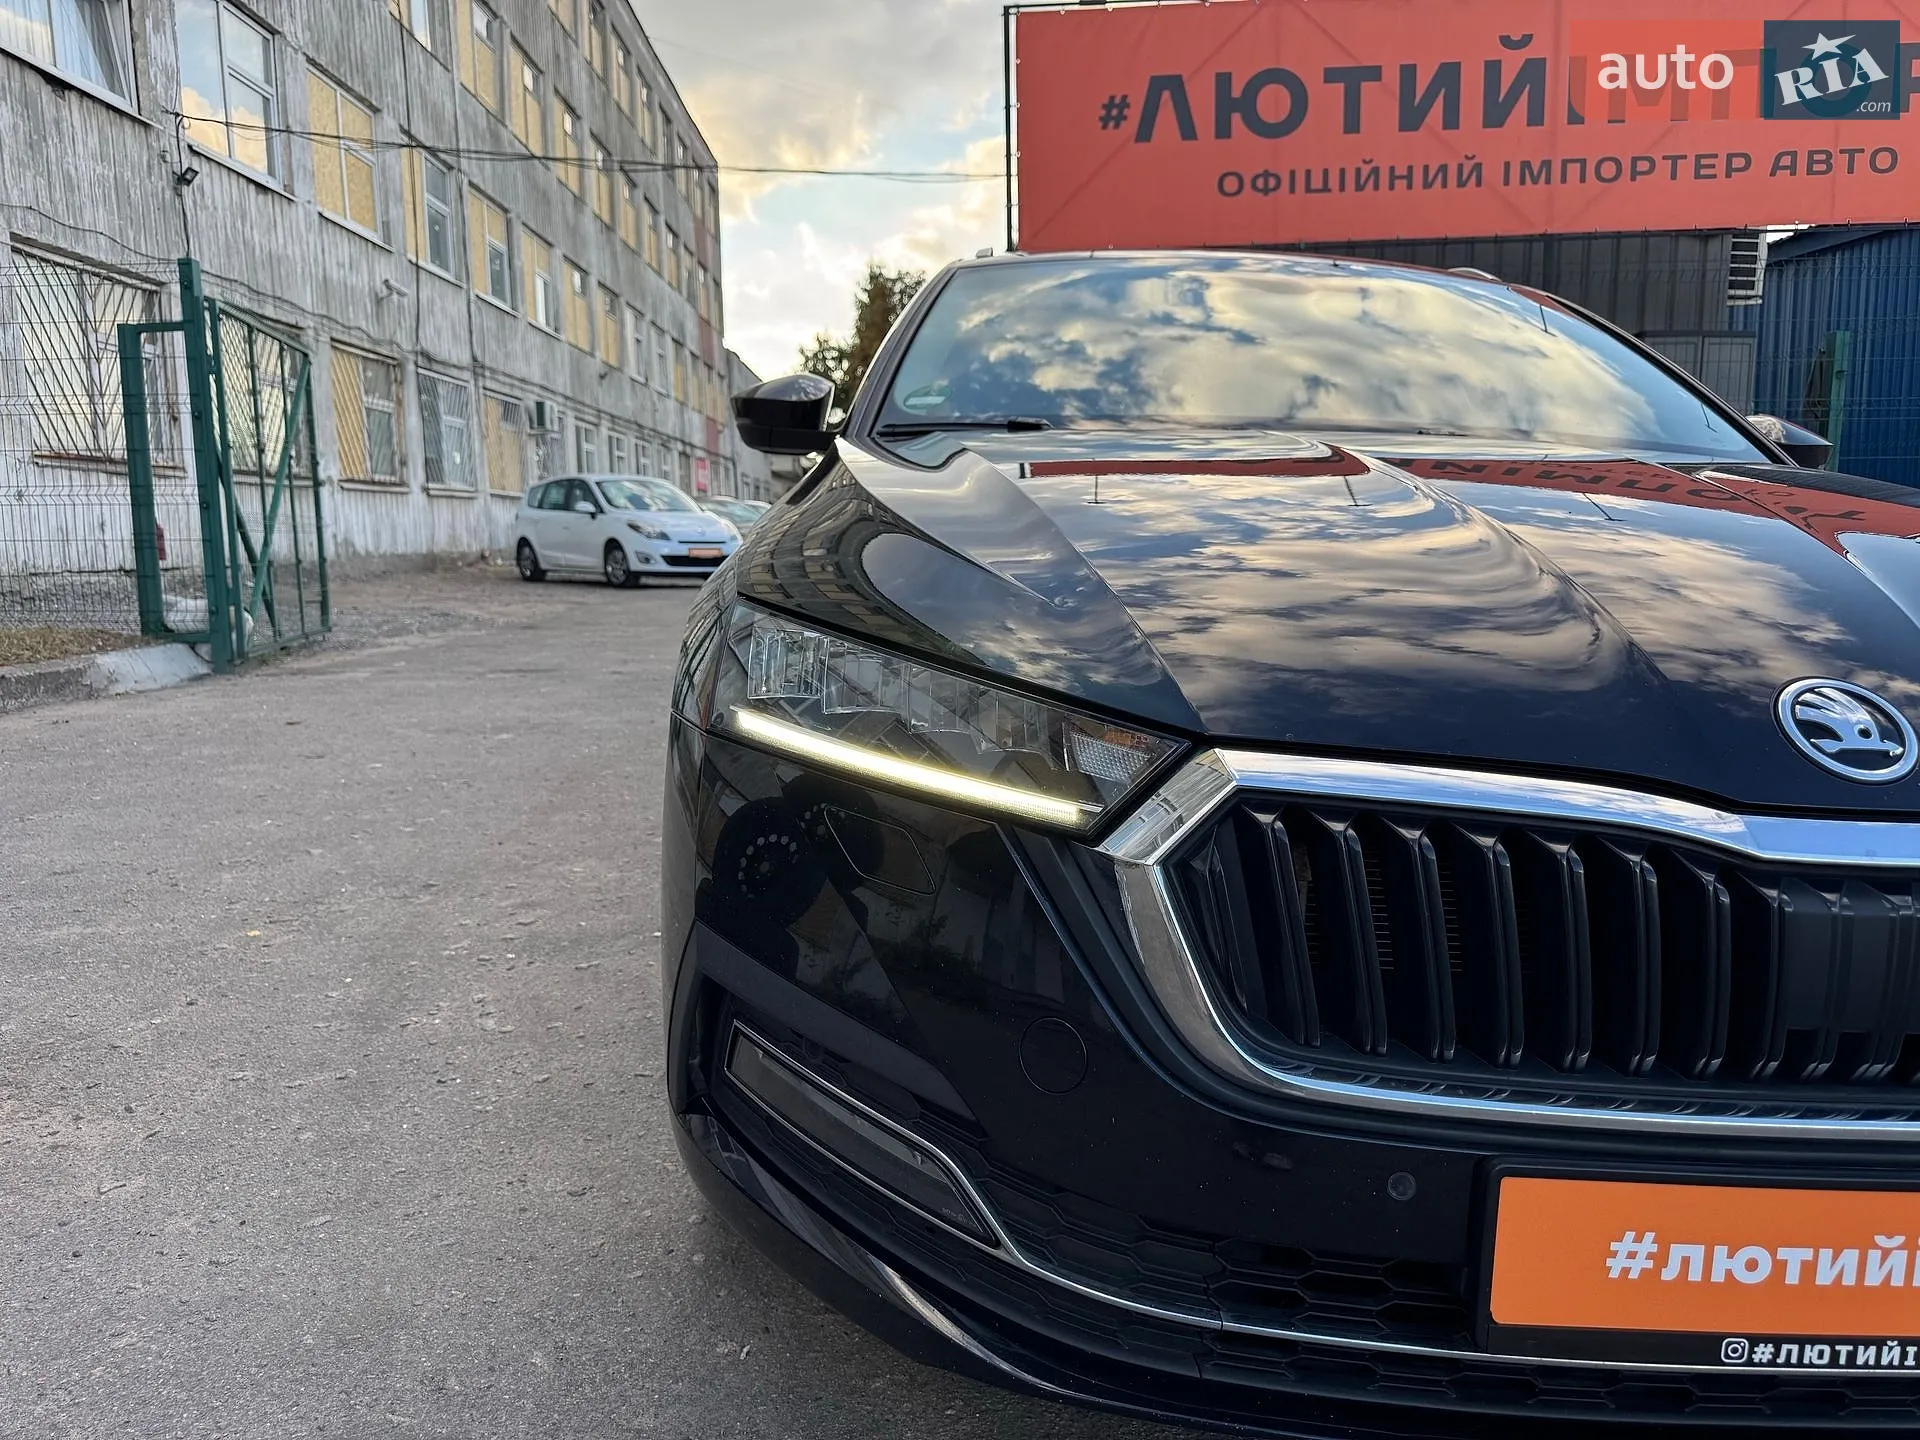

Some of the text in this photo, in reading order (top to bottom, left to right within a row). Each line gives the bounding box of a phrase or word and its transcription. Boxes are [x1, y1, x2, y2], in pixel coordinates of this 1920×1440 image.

[1217, 146, 1899, 197] ОФІЦІЙНИЙ ІМПОРТЕР АВТО
